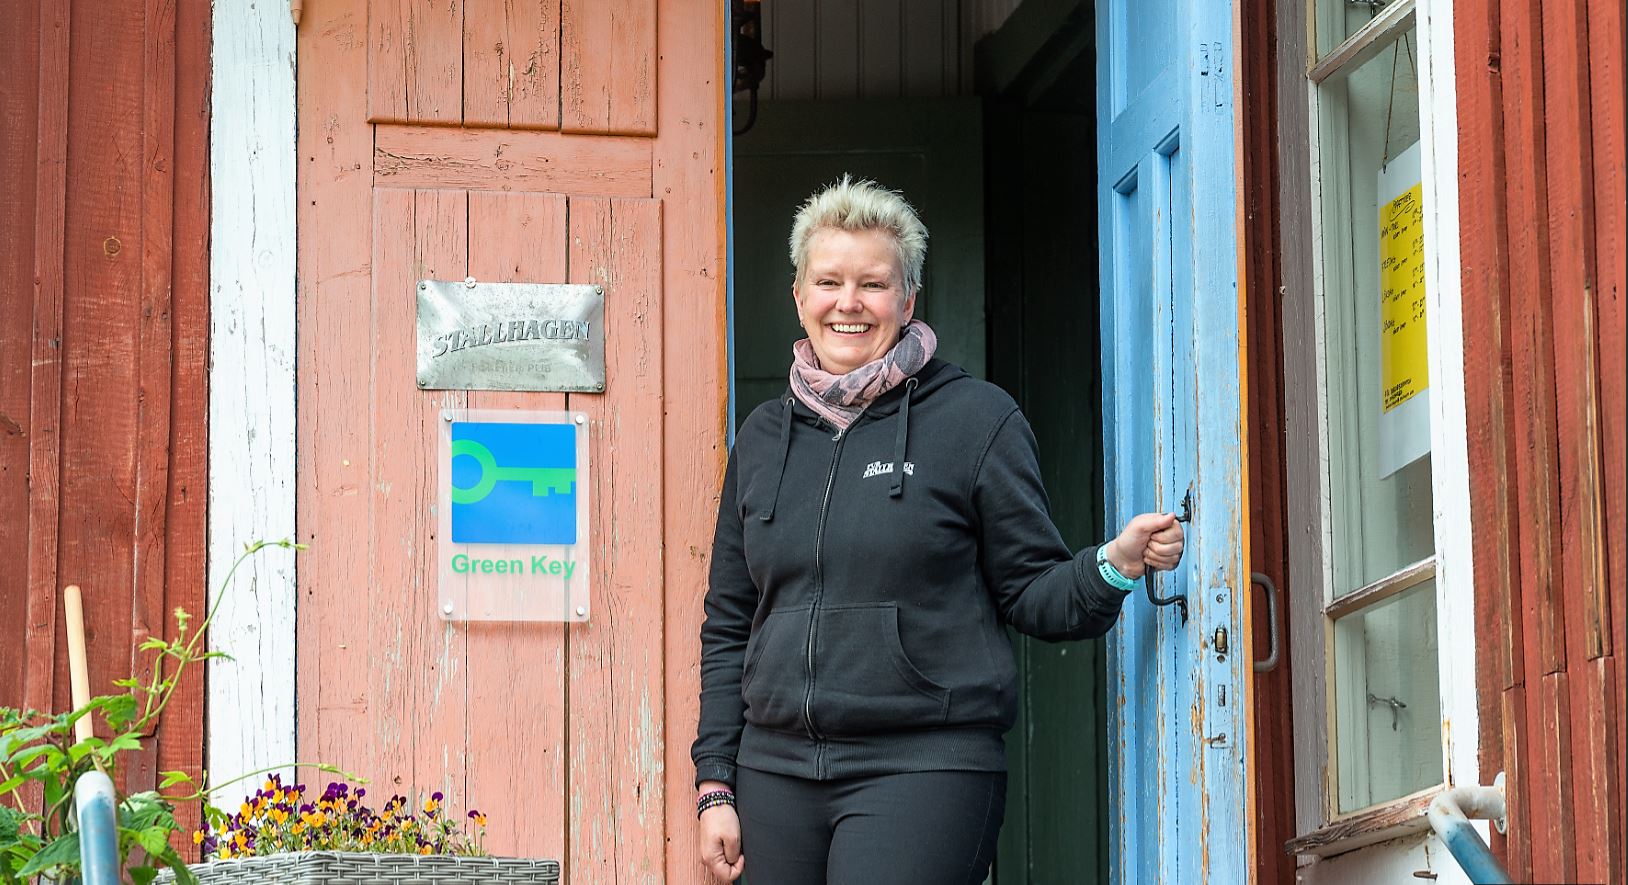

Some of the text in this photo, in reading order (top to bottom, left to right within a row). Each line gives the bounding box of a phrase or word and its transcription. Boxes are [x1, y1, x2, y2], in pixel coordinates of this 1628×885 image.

[432, 319, 590, 358] STALLHAGEN
[451, 554, 576, 580] Green Key
